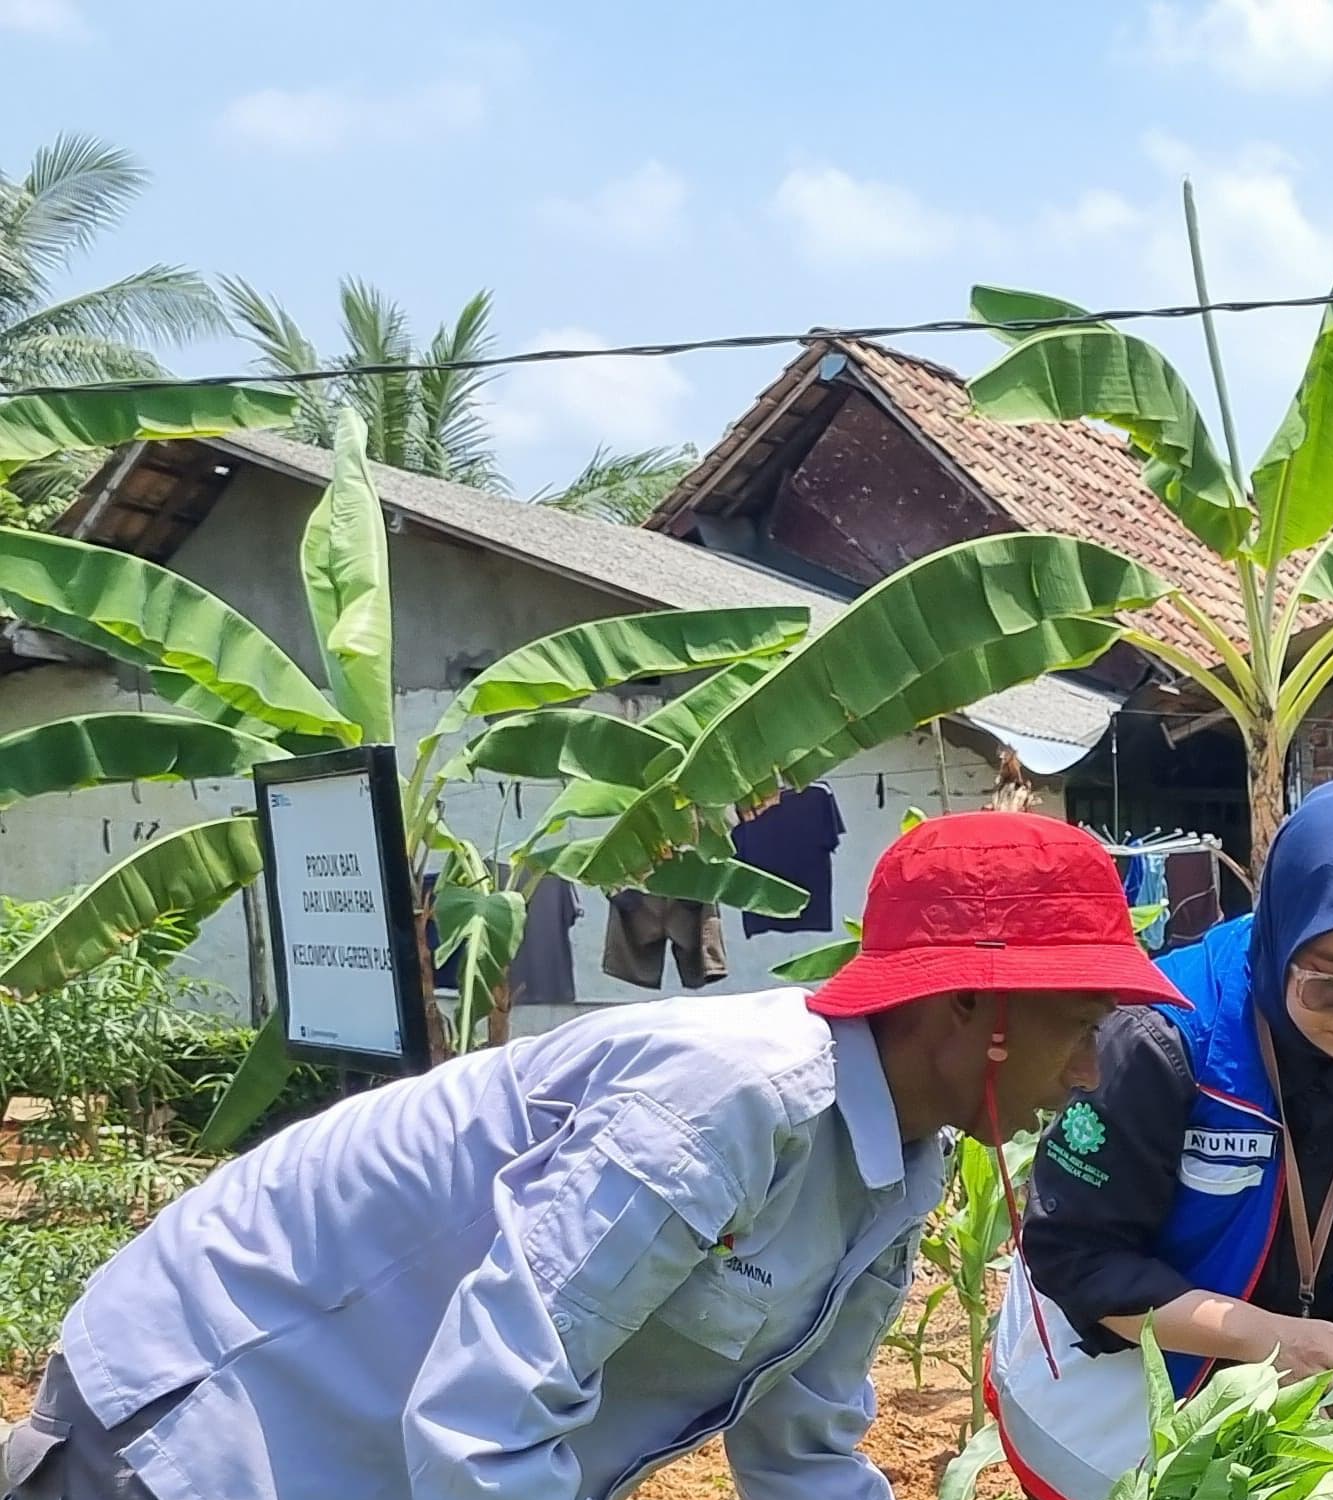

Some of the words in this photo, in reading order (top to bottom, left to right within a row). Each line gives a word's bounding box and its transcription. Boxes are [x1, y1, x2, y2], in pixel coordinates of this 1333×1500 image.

[306, 854, 338, 877] PRODUK
[339, 853, 362, 877] BATA
[302, 890, 323, 913] DARI
[323, 890, 355, 913] LIMBAH
[292, 944, 336, 967] KELOMPOK
[336, 945, 374, 969] U-GREEN
[1191, 1134, 1258, 1153] AYUNIR
